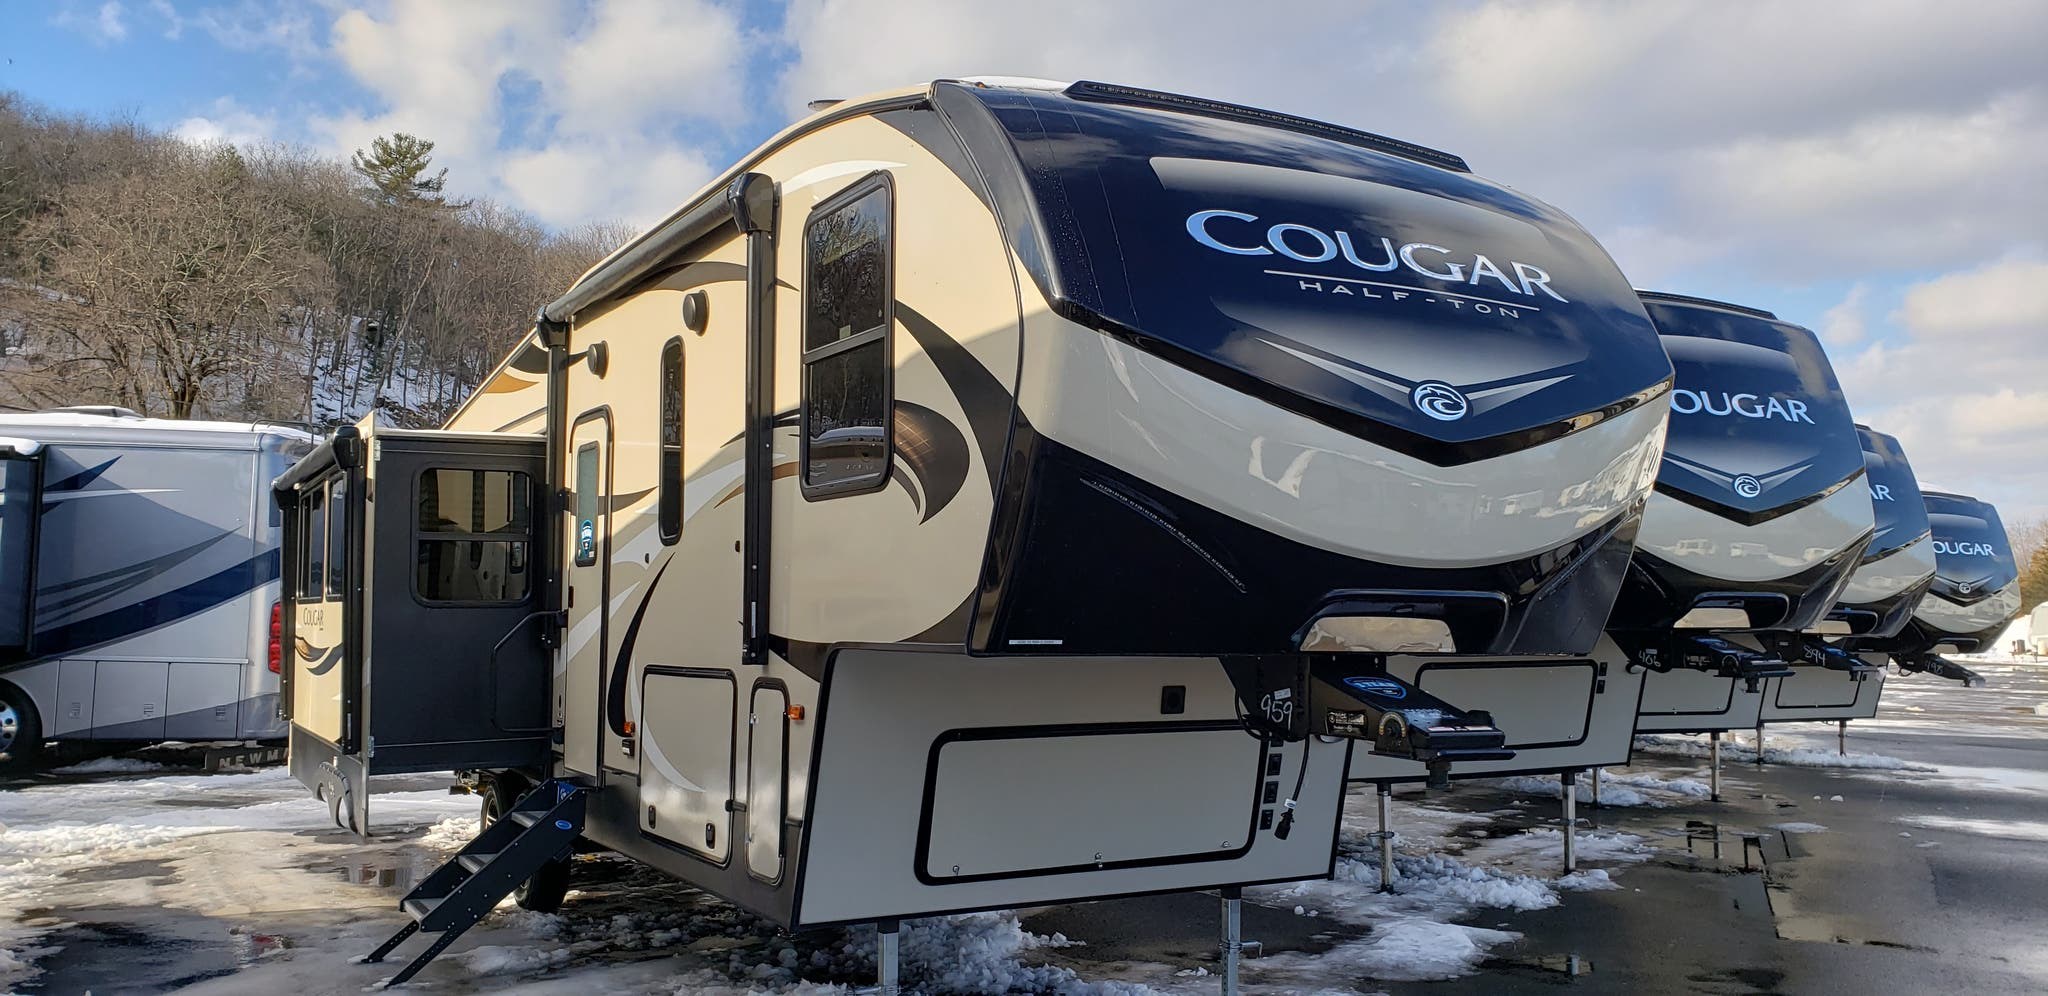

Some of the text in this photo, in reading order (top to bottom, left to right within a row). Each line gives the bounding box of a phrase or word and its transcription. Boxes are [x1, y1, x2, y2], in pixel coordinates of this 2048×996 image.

[1186, 209, 1569, 304] COUGAR
[1299, 280, 1520, 320] HALF-TON
[1670, 388, 1816, 425] OUGAR
[1932, 540, 1998, 557] OUGAR
[1803, 644, 1826, 667] 894
[1261, 694, 1293, 730] 959
